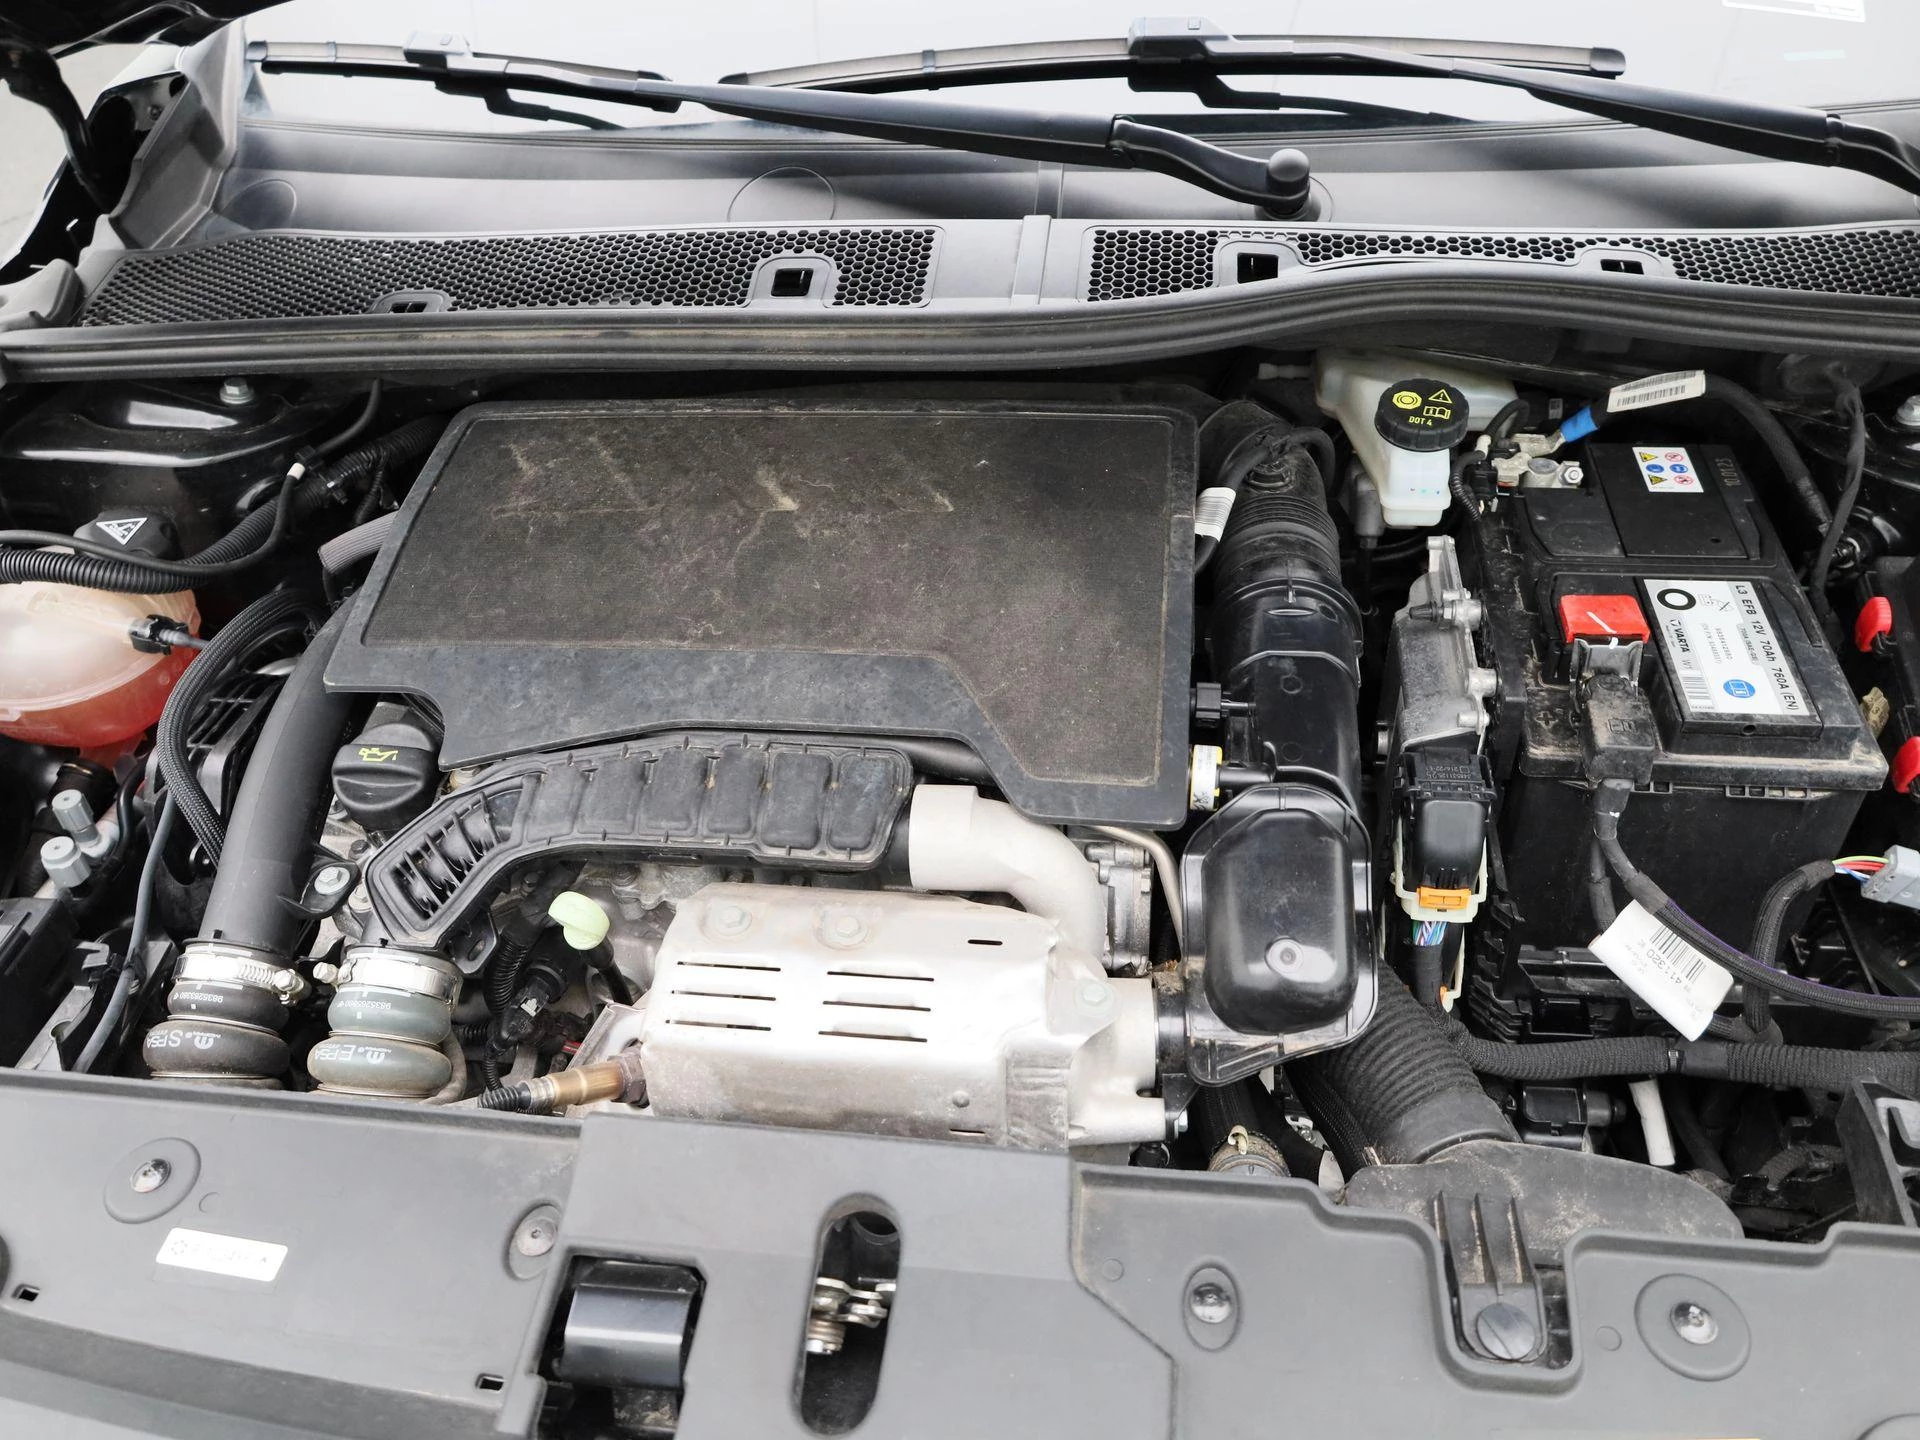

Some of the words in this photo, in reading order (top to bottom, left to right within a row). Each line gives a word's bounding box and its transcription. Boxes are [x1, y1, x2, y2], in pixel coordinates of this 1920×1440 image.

[1409, 416, 1425, 424] DOT
[1673, 628, 1690, 652] VARTA
[1734, 585, 1748, 594] L3
[1741, 599, 1756, 614] EFB
[1750, 620, 1766, 634] 12V
[1759, 640, 1777, 661] 70Ah
[1770, 667, 1789, 688] 760A
[1780, 692, 1799, 710] (EN)
[1647, 949, 1682, 983] 411320
[147, 1035, 168, 1048] PSA
